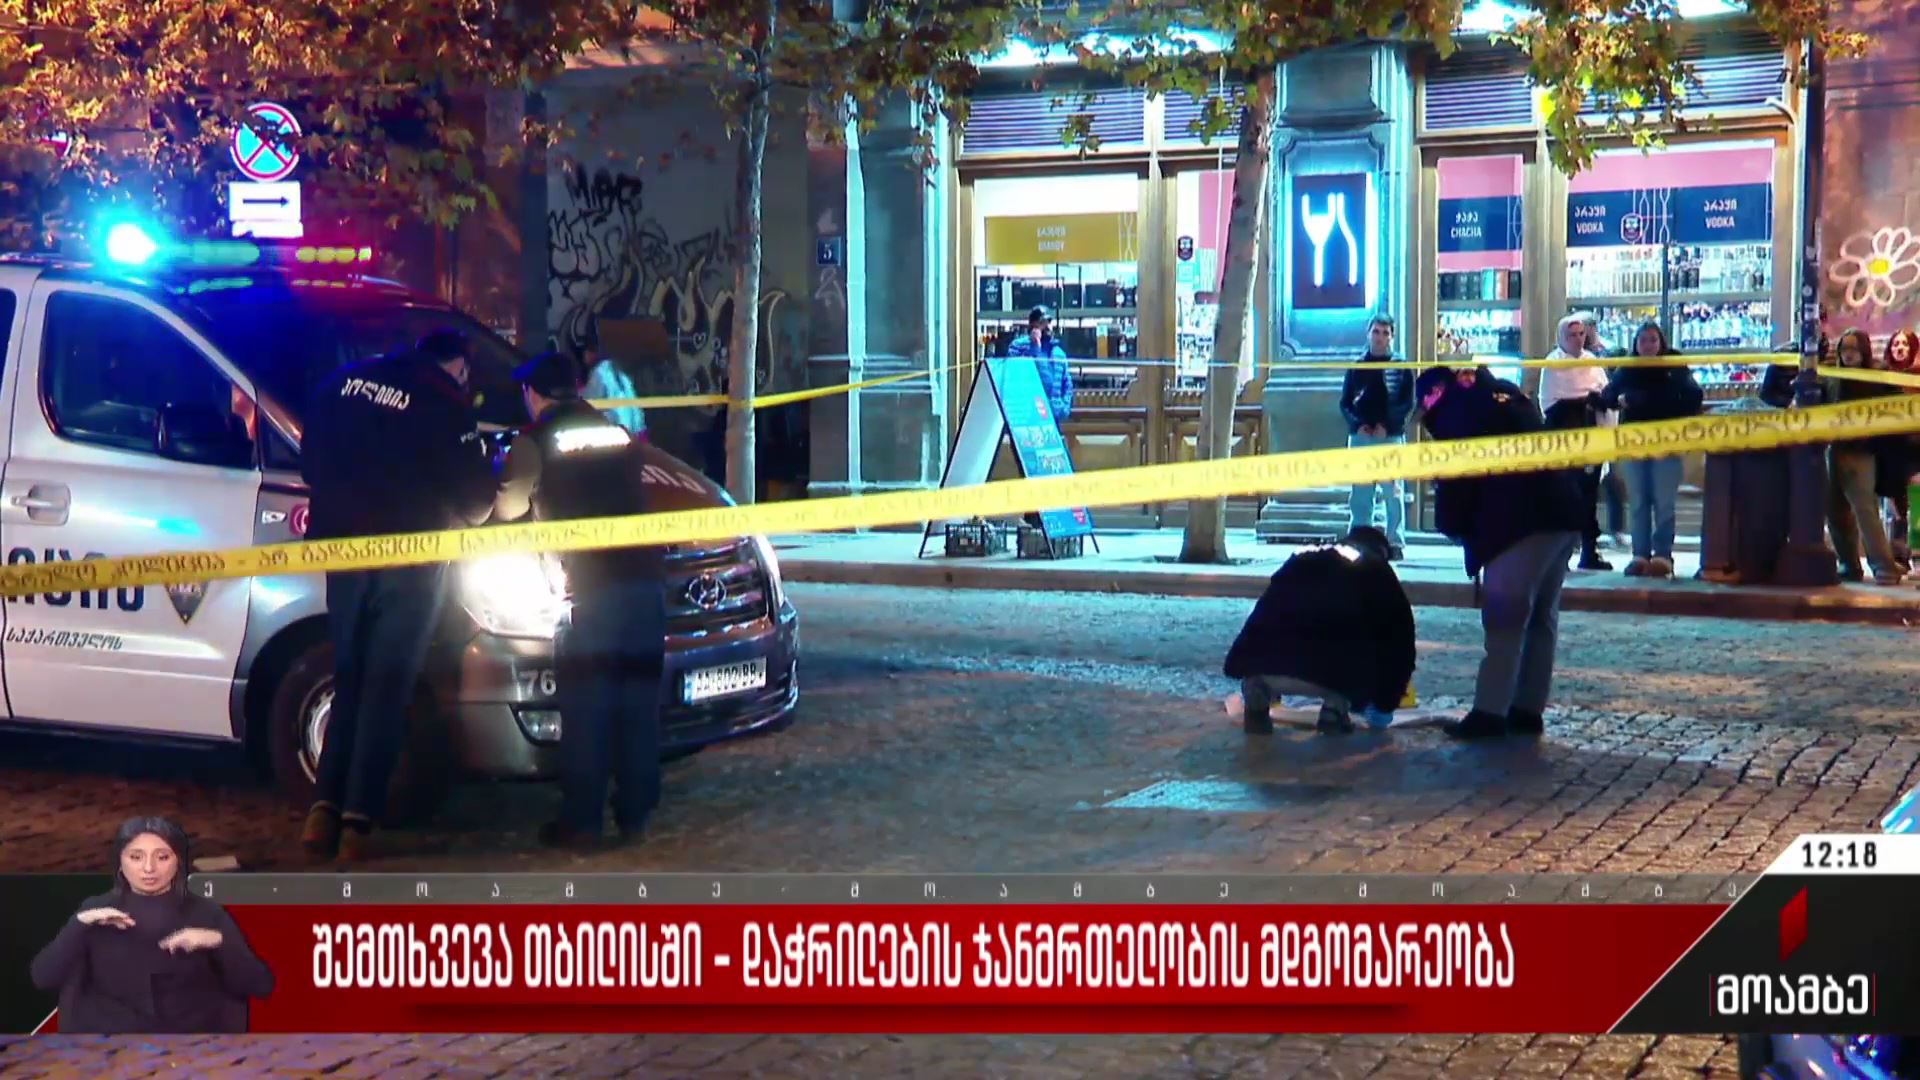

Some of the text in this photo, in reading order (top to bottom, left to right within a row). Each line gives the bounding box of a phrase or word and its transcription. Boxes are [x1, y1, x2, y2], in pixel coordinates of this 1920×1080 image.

[1576, 221, 1604, 234] VODKA
[1705, 216, 1735, 229] VODKA
[1451, 226, 1482, 238] CHACHA
[823, 243, 832, 260] 5
[341, 377, 410, 410] პოლიცია
[6, 627, 123, 650] საქართველოს
